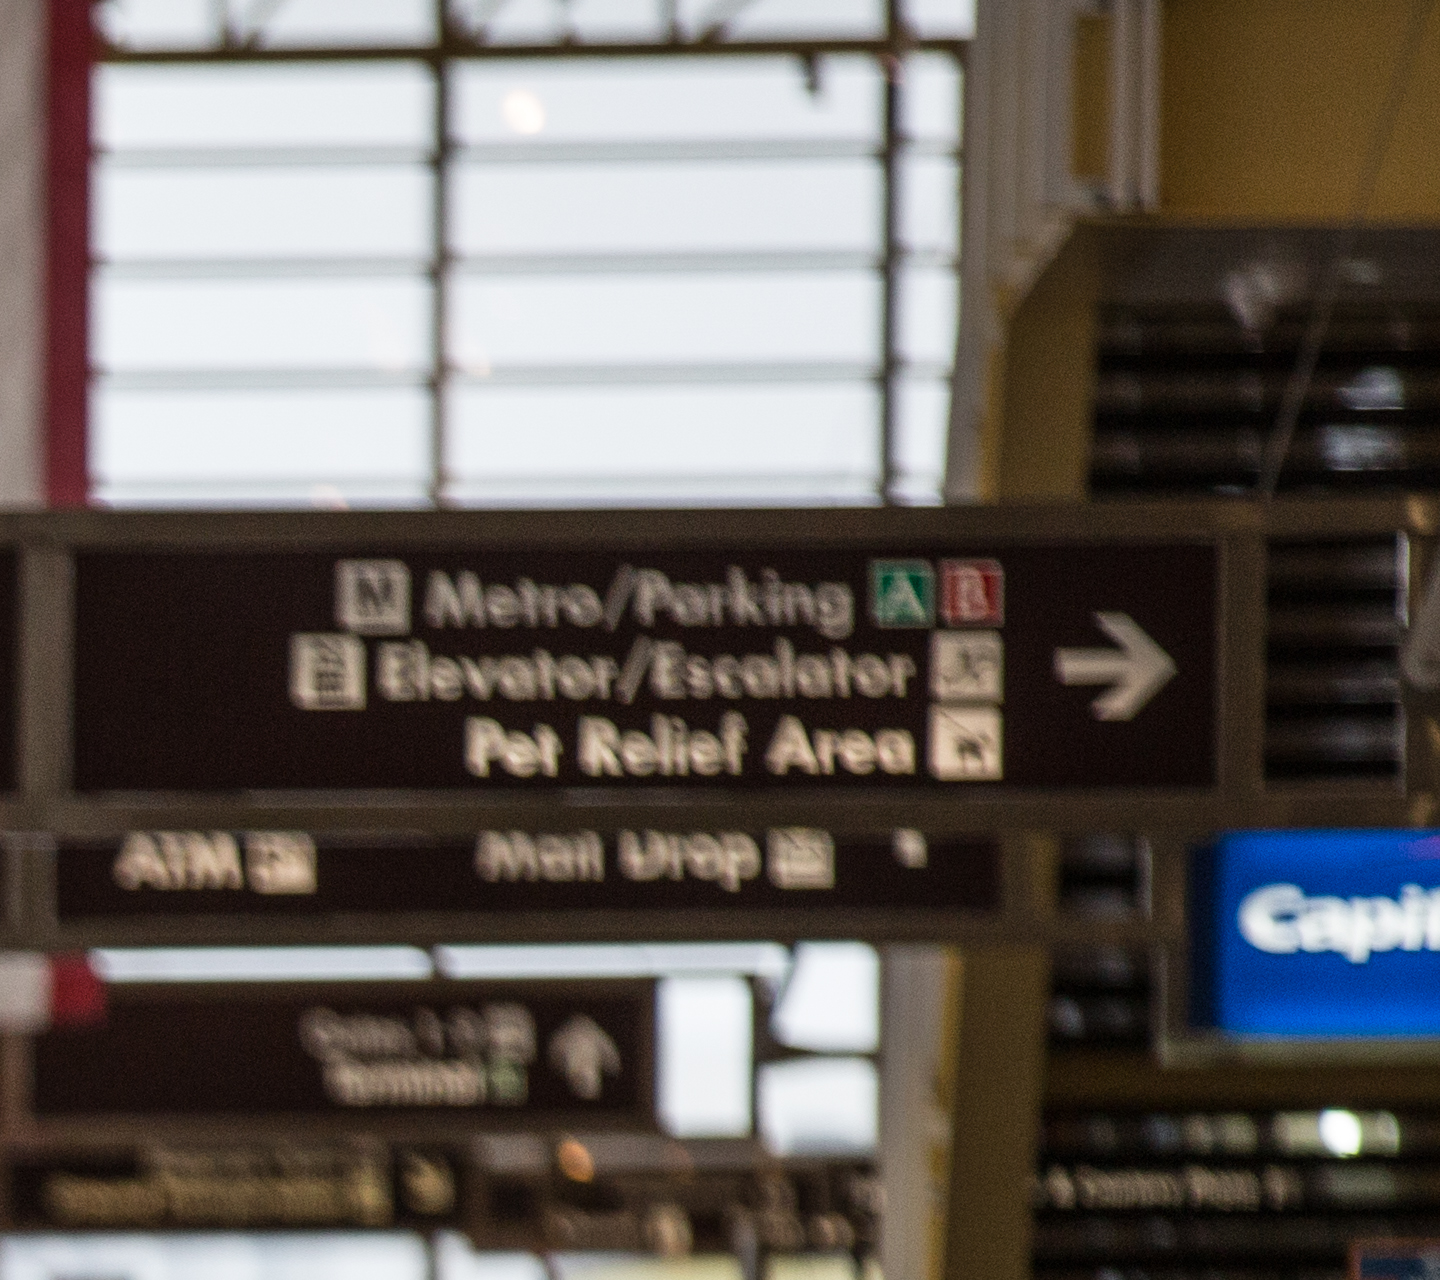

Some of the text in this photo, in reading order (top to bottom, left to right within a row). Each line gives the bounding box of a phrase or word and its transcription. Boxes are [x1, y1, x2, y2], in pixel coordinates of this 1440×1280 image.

[424, 567, 854, 640] Metro/Parking
[376, 642, 916, 705] Elevator/Escalator
[465, 714, 917, 777] Pet Relief Area
[114, 831, 244, 890] ATM
[476, 831, 604, 882] Mail
